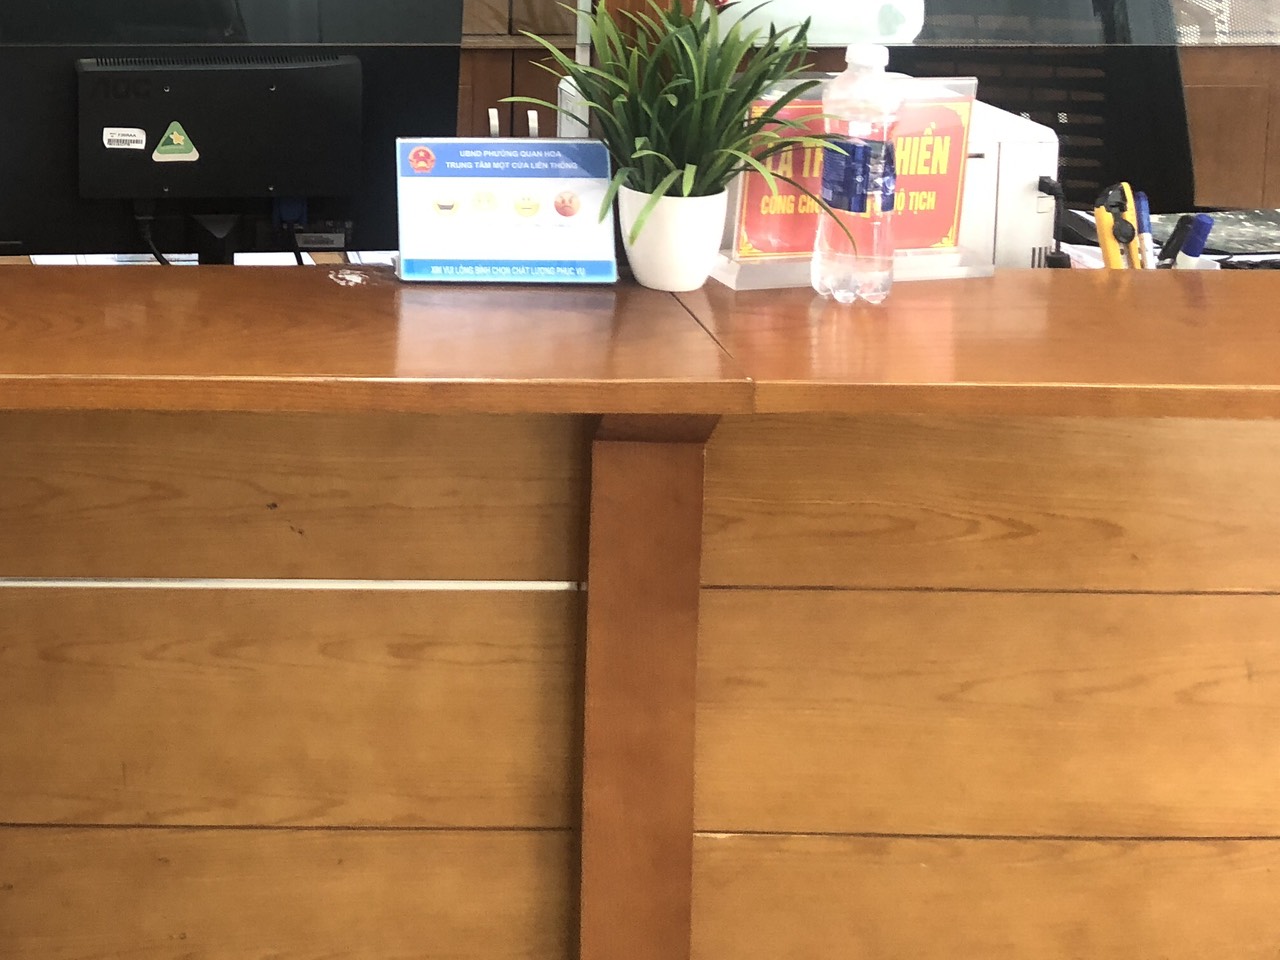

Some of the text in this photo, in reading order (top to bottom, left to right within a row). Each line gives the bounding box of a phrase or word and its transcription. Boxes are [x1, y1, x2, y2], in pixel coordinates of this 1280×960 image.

[459, 148, 562, 159] UBND PHƯỜNG QUAN HOA
[445, 161, 473, 170] TRUNG
[474, 160, 492, 169] TÂM
[492, 160, 510, 171] MỘT
[530, 160, 549, 170] LIÊN
[550, 160, 578, 170] THÔNG
[908, 191, 937, 214] TỊCH
